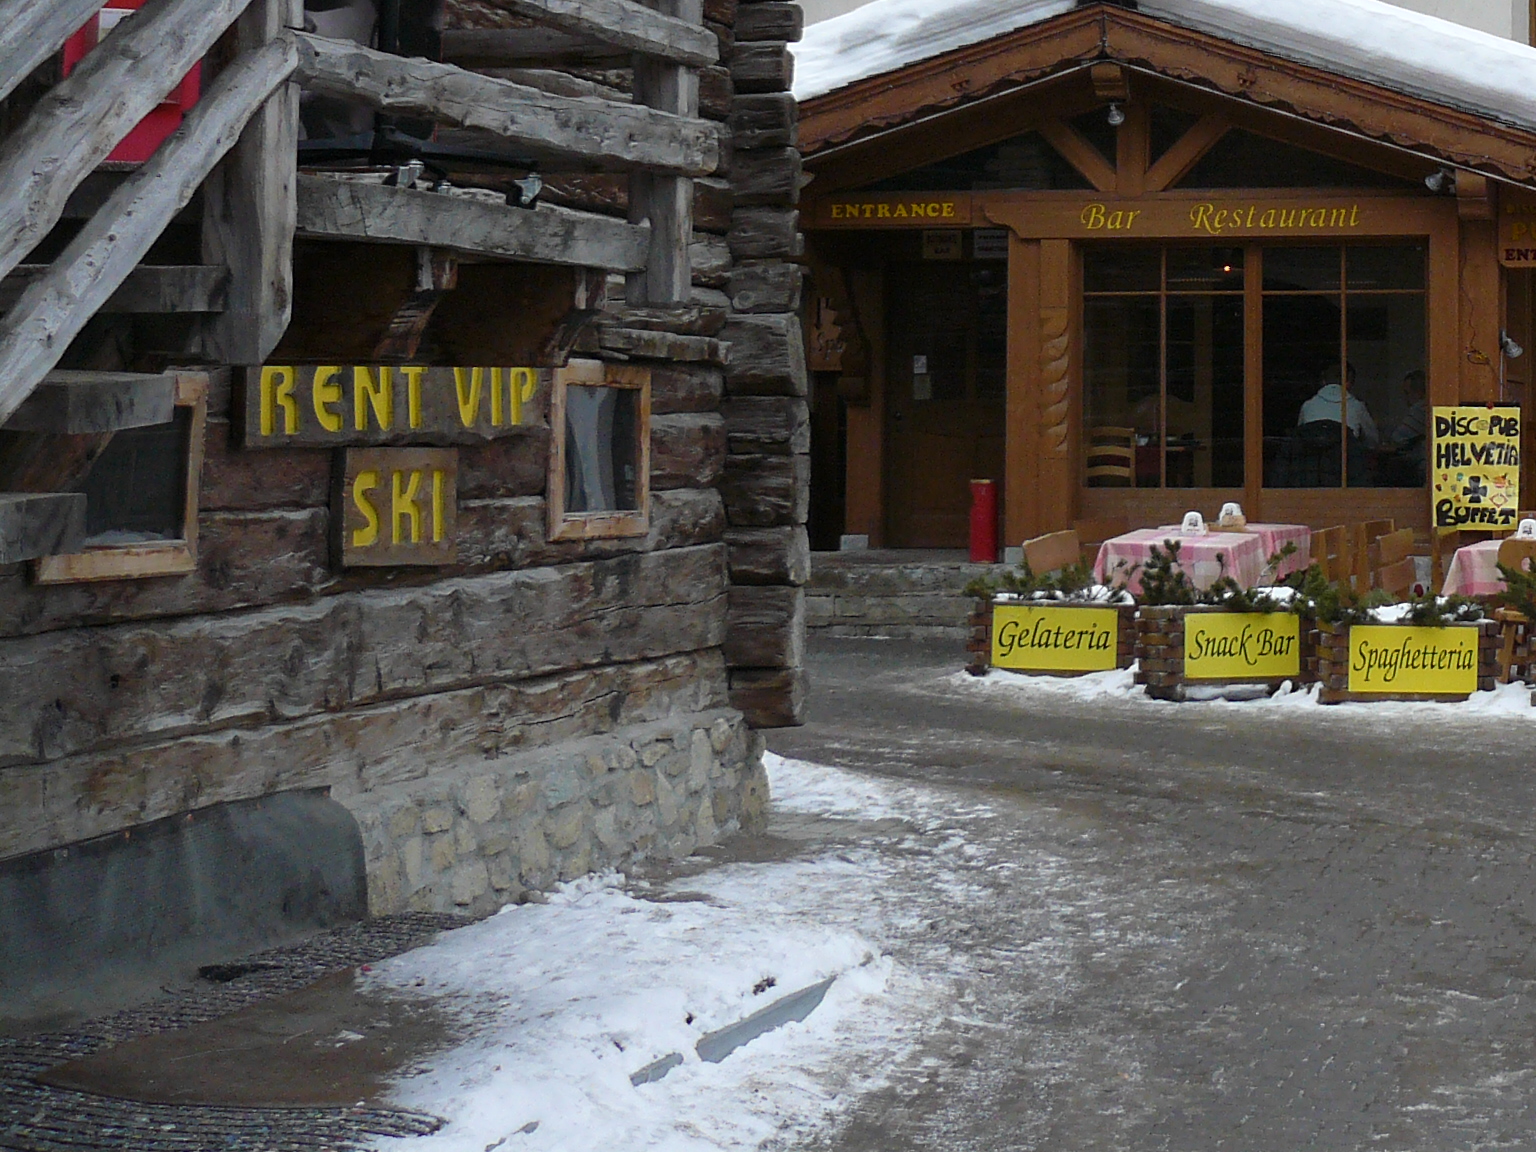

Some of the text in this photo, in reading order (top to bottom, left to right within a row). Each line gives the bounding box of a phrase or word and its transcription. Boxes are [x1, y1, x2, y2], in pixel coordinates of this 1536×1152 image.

[830, 202, 956, 219] ENTRANCE
[1080, 202, 1361, 234] Bar Restaurant
[259, 365, 539, 436] RENT VIP
[1487, 415, 1519, 437] PUB
[353, 469, 445, 547] SKI
[1436, 498, 1517, 527] BUFFET
[998, 617, 1112, 658] Gelateria
[1188, 623, 1296, 666] Snack Bar
[1353, 635, 1476, 683] Spaghetteria
